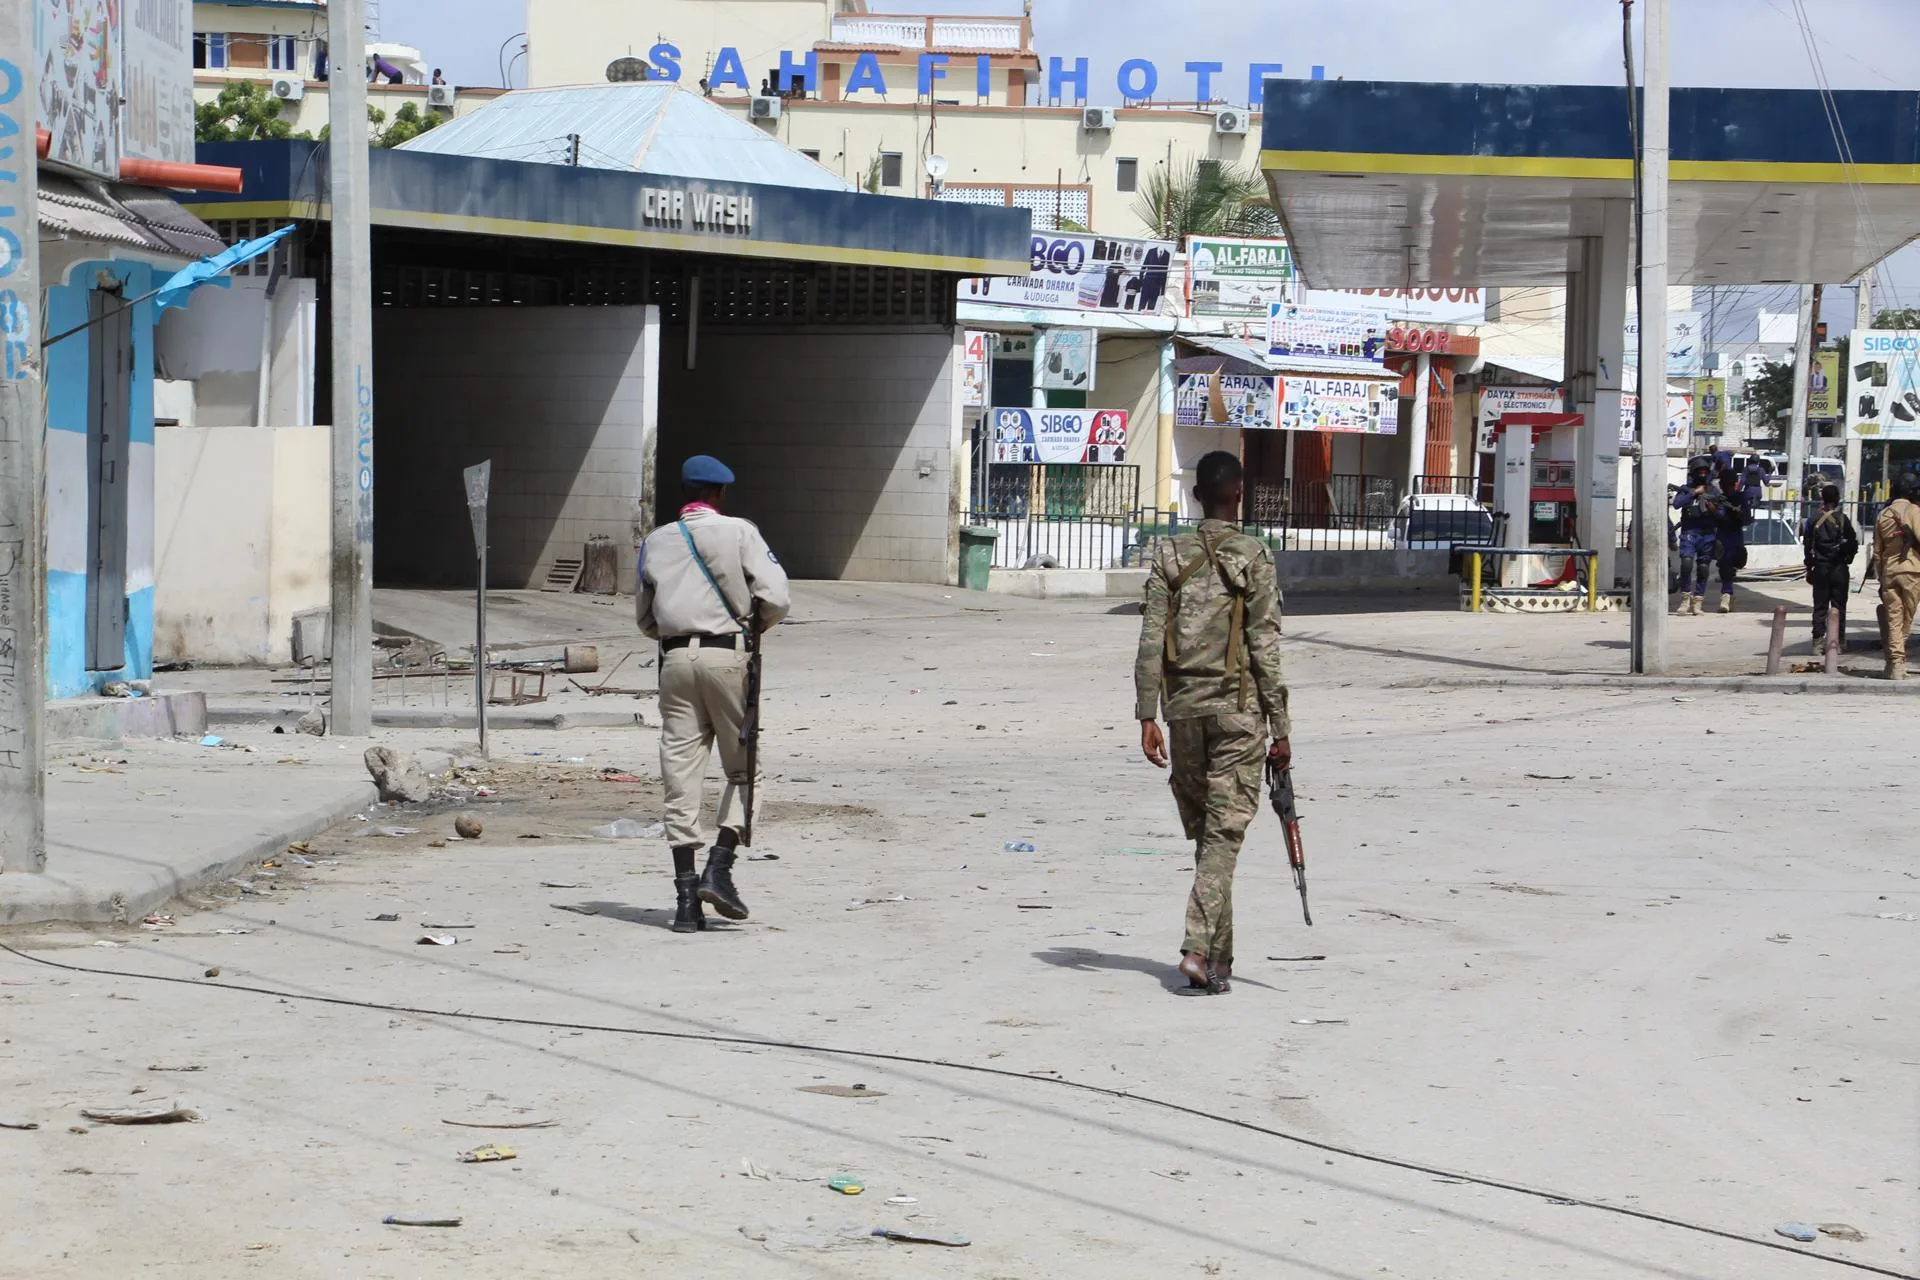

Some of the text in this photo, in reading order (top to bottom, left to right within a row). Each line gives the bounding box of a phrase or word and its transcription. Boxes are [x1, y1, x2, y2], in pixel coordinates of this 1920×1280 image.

[648, 43, 990, 97] SAHAFI
[641, 188, 752, 226] CAR WASH
[1216, 246, 1286, 267] AL-FARAJ
[1267, 268, 1285, 276] AGENCY
[1007, 277, 1075, 292] CARWADA DHARKA
[1031, 292, 1059, 303] UDUGGA
[967, 336, 986, 361] 4
[1864, 337, 1919, 352] SIBCO
[1303, 379, 1367, 398] AL-FARAJ
[1487, 389, 1516, 400] DAYAX
[1503, 400, 1547, 409] ELECTRONICS
[1040, 414, 1082, 434] SIBCO
